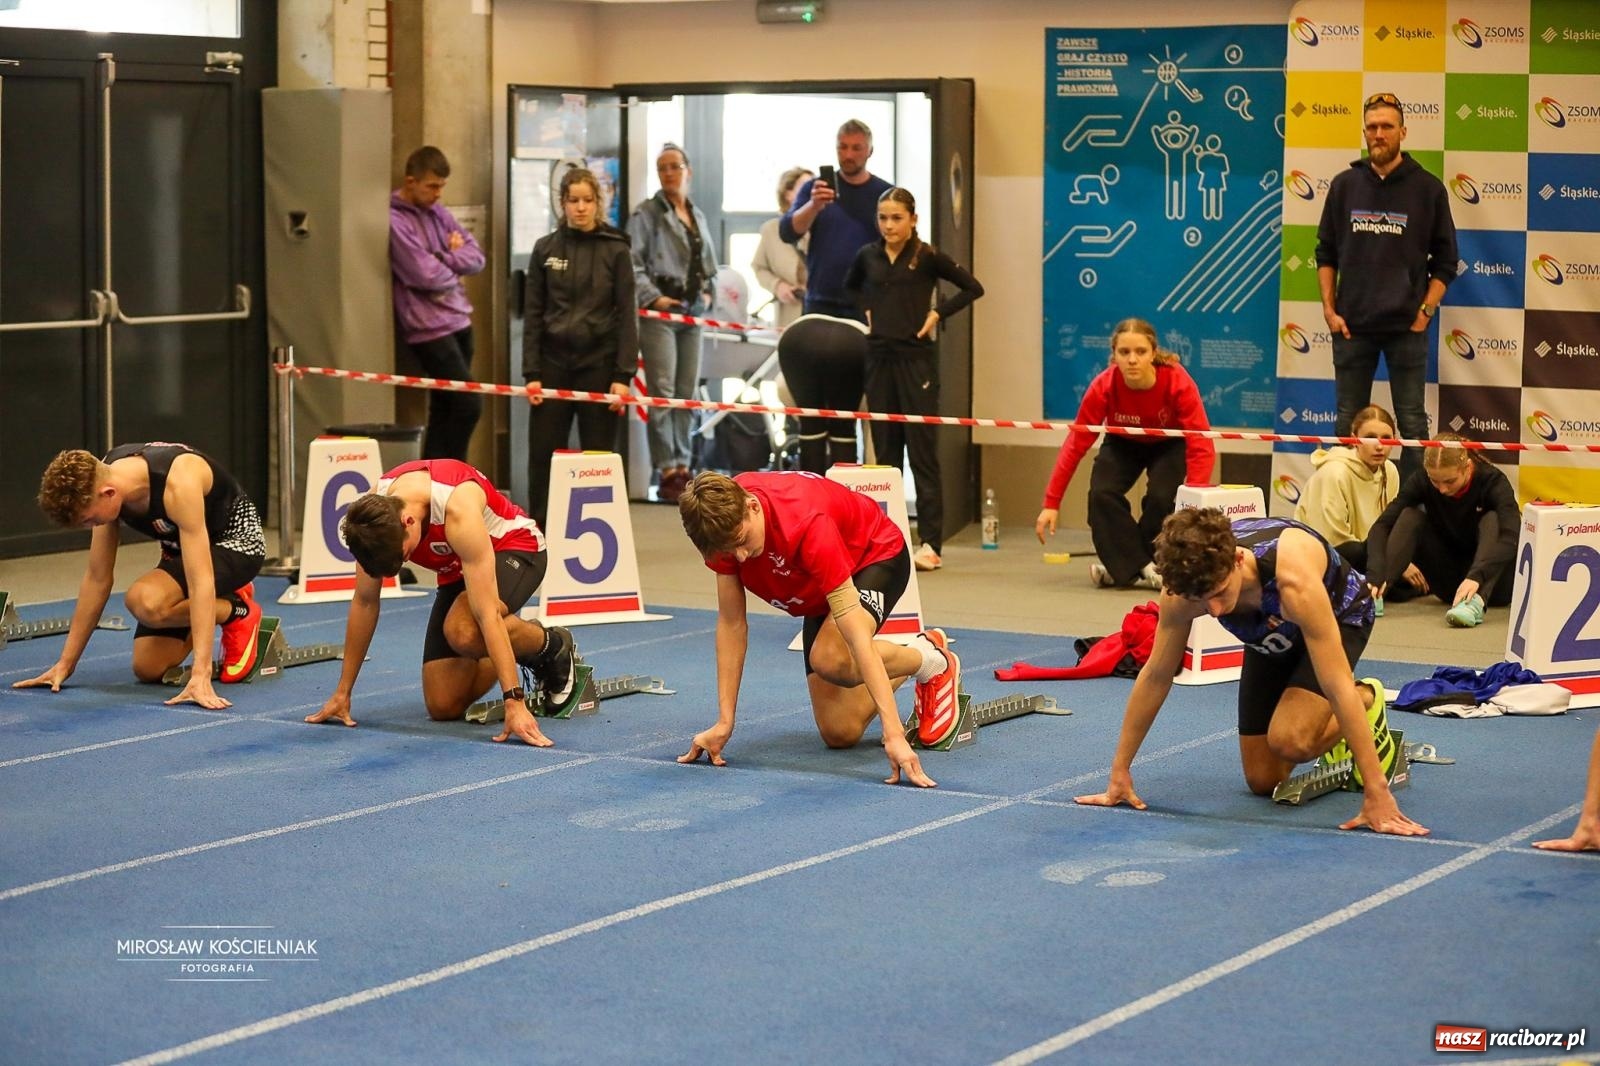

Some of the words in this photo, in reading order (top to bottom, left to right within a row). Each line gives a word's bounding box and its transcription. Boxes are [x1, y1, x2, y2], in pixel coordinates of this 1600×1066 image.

[1321, 25, 1359, 35] ZSOMS
[1395, 27, 1435, 40] Śląskie.
[1484, 27, 1524, 38] ZSOMS
[1057, 38, 1097, 47] ZAWSZE
[1087, 54, 1127, 62] CZYSTO
[1065, 69, 1111, 77] HISTORIA
[1057, 84, 1117, 92] PRAWDZIWA
[1311, 104, 1351, 117] Śląskie.
[1401, 103, 1439, 114] ZSOMS
[1477, 106, 1517, 119] Śląskie.
[1567, 106, 1600, 117] ZSOM
[1482, 183, 1522, 193] ZSOMS
[1352, 222, 1403, 235] patagonia
[1473, 260, 1514, 275] Śląskie.
[1566, 264, 1600, 274] ZSOM
[1312, 332, 1333, 343] ZSO
[1477, 339, 1517, 350] ZSOMS
[1556, 341, 1598, 357] Śląskie.
[1301, 408, 1338, 424] Śląski
[1469, 416, 1509, 431] Śląskie.
[1560, 420, 1600, 432] ZSOMS
[579, 468, 613, 479] polanik
[856, 482, 891, 493] polanik
[1227, 503, 1256, 516] polanik
[321, 471, 371, 562] 6
[564, 486, 618, 584] 5
[1566, 523, 1600, 537] polanik
[1510, 542, 1533, 659] 2
[1551, 545, 1600, 662] 2
